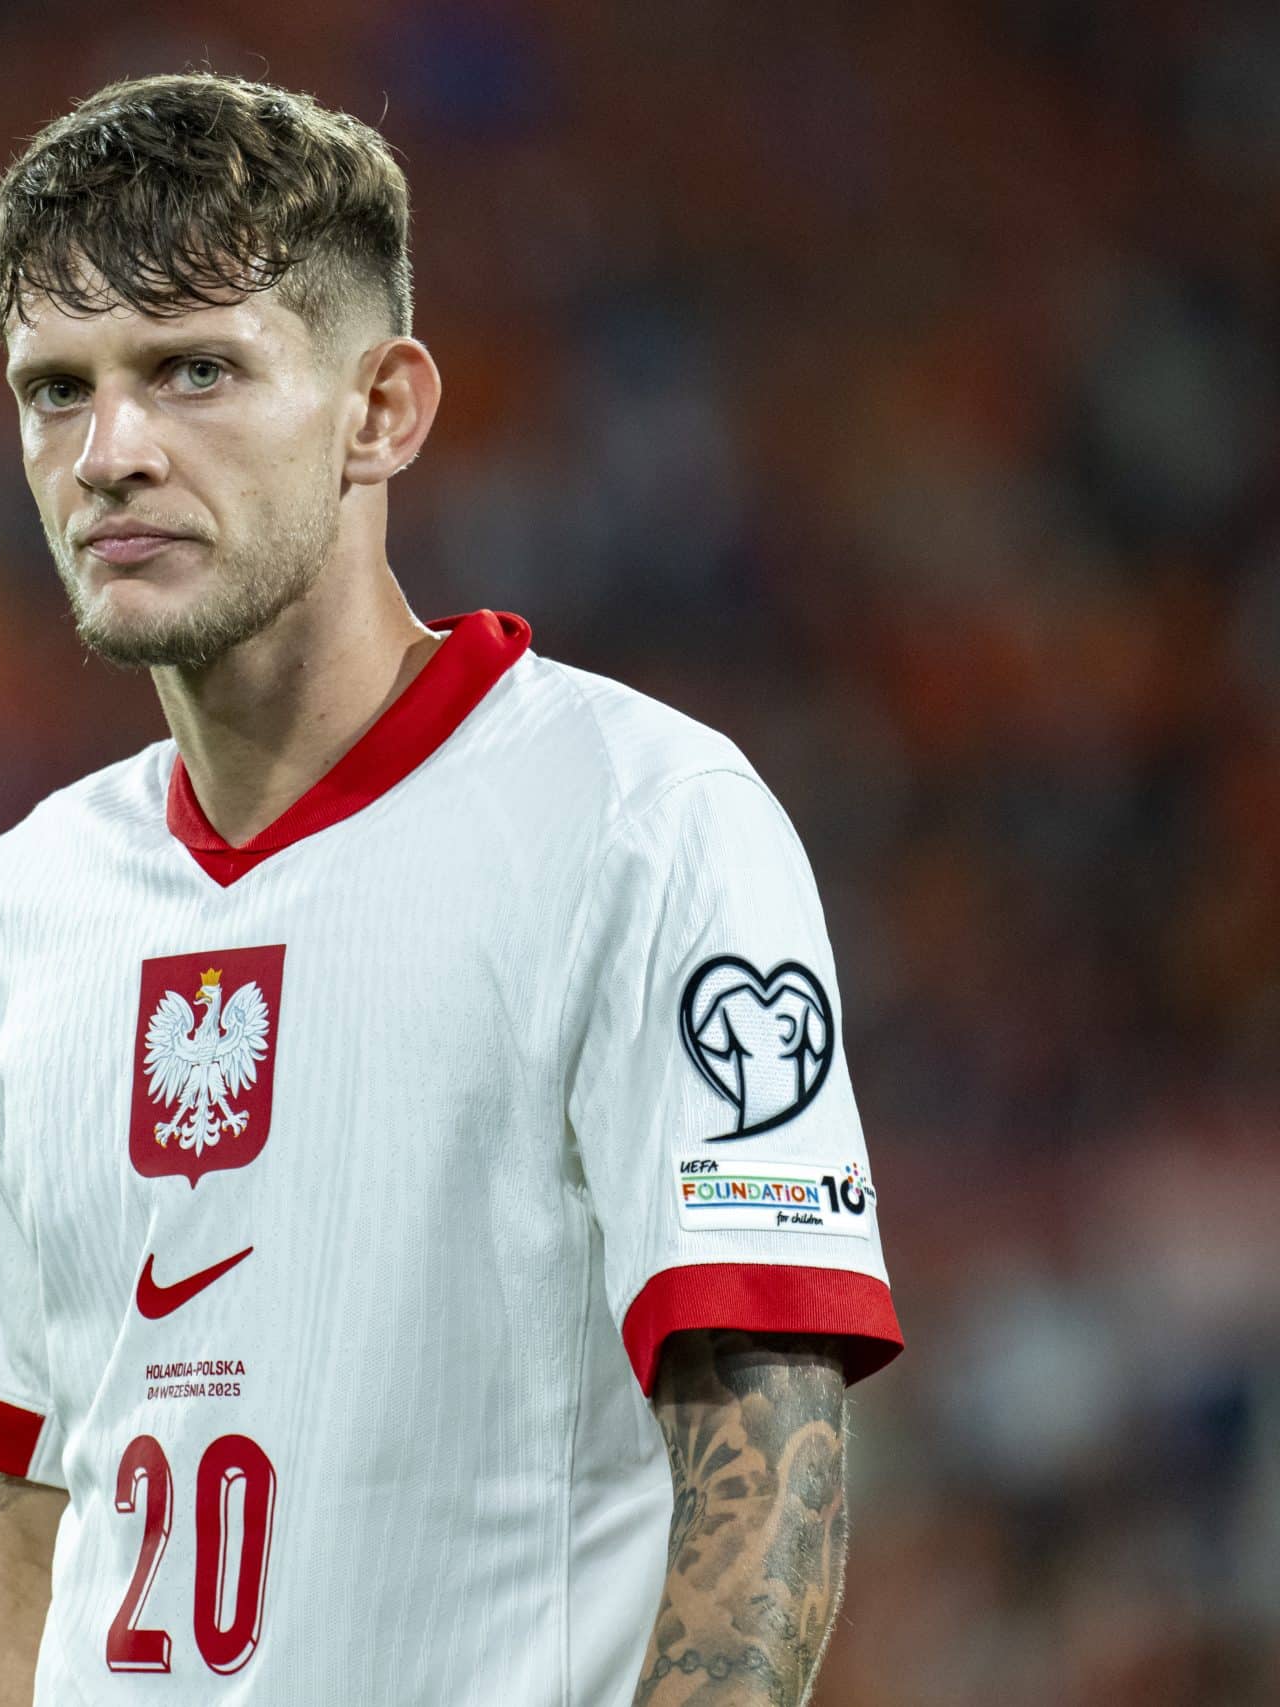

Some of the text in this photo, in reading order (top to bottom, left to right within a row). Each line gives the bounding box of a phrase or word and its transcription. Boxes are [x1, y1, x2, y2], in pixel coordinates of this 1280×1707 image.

[680, 1160, 719, 1174] UEFA
[821, 1175, 866, 1215] 10
[777, 1211, 824, 1226] for children
[207, 1383, 241, 1397] 2025
[106, 1434, 278, 1675] 20
